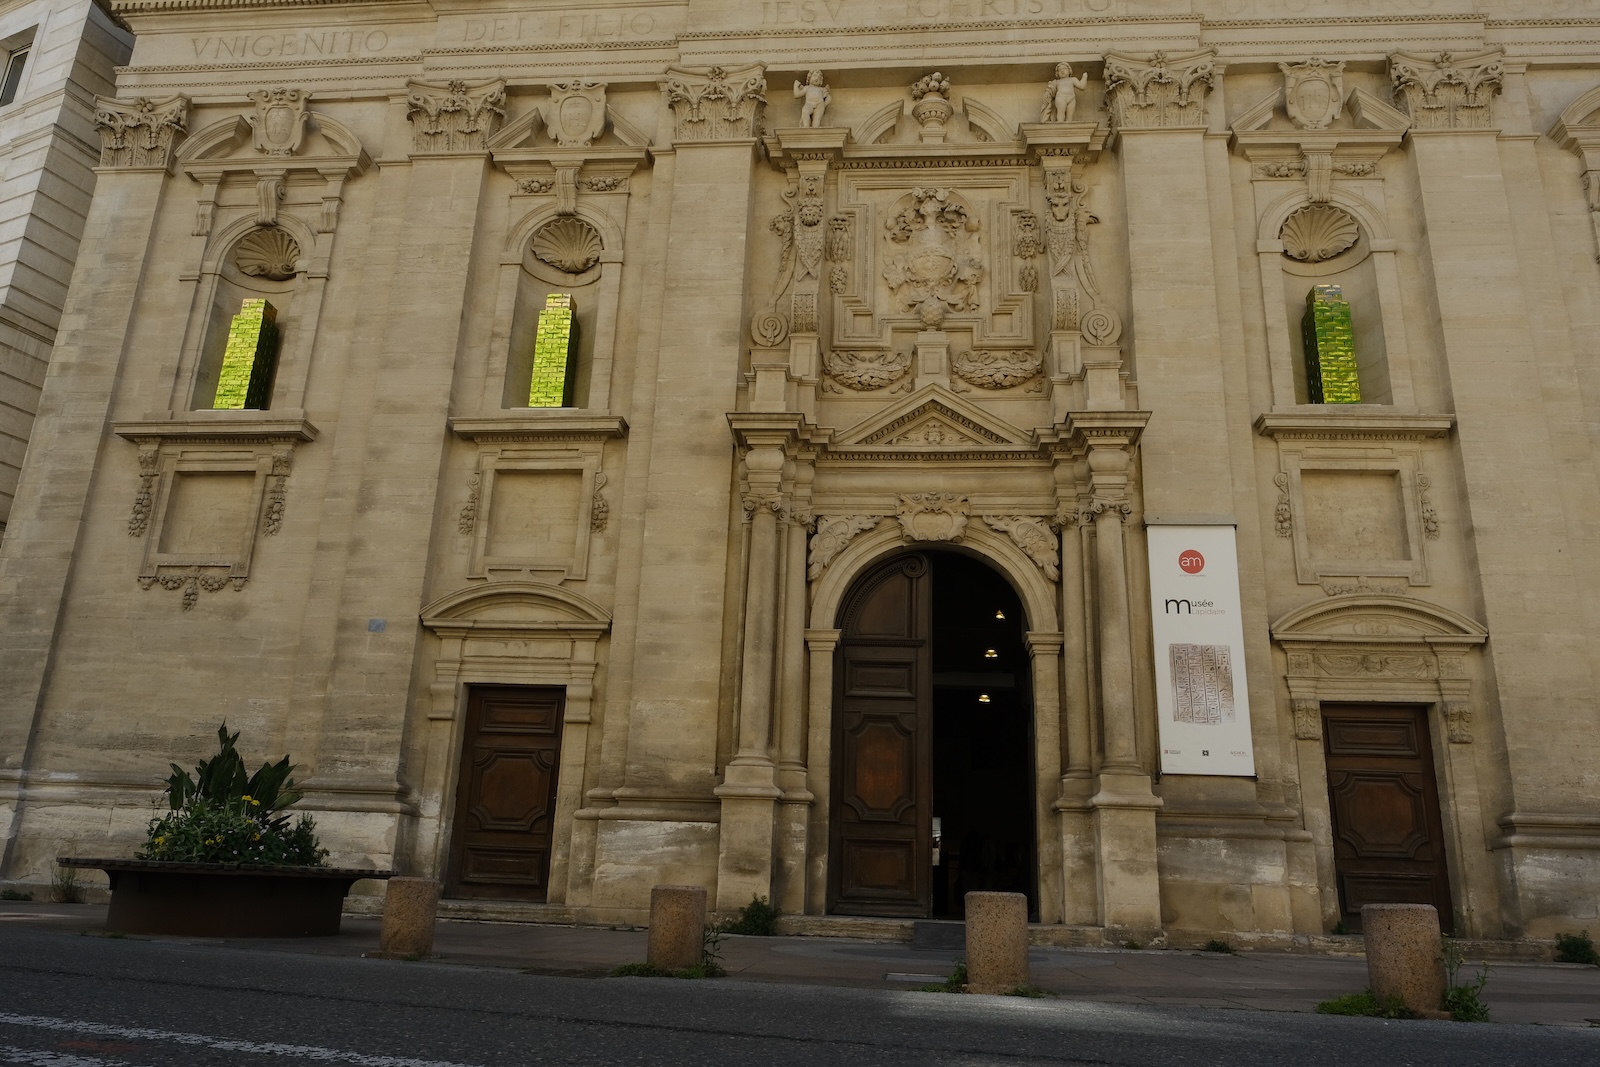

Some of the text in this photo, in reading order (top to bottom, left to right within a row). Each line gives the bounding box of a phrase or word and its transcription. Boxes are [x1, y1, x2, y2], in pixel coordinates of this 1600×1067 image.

[191, 30, 388, 58] VNIGENITO
[463, 18, 527, 42] DEI
[557, 12, 656, 39] FILIO
[1181, 556, 1202, 567] am
[1165, 599, 1214, 615] musée
